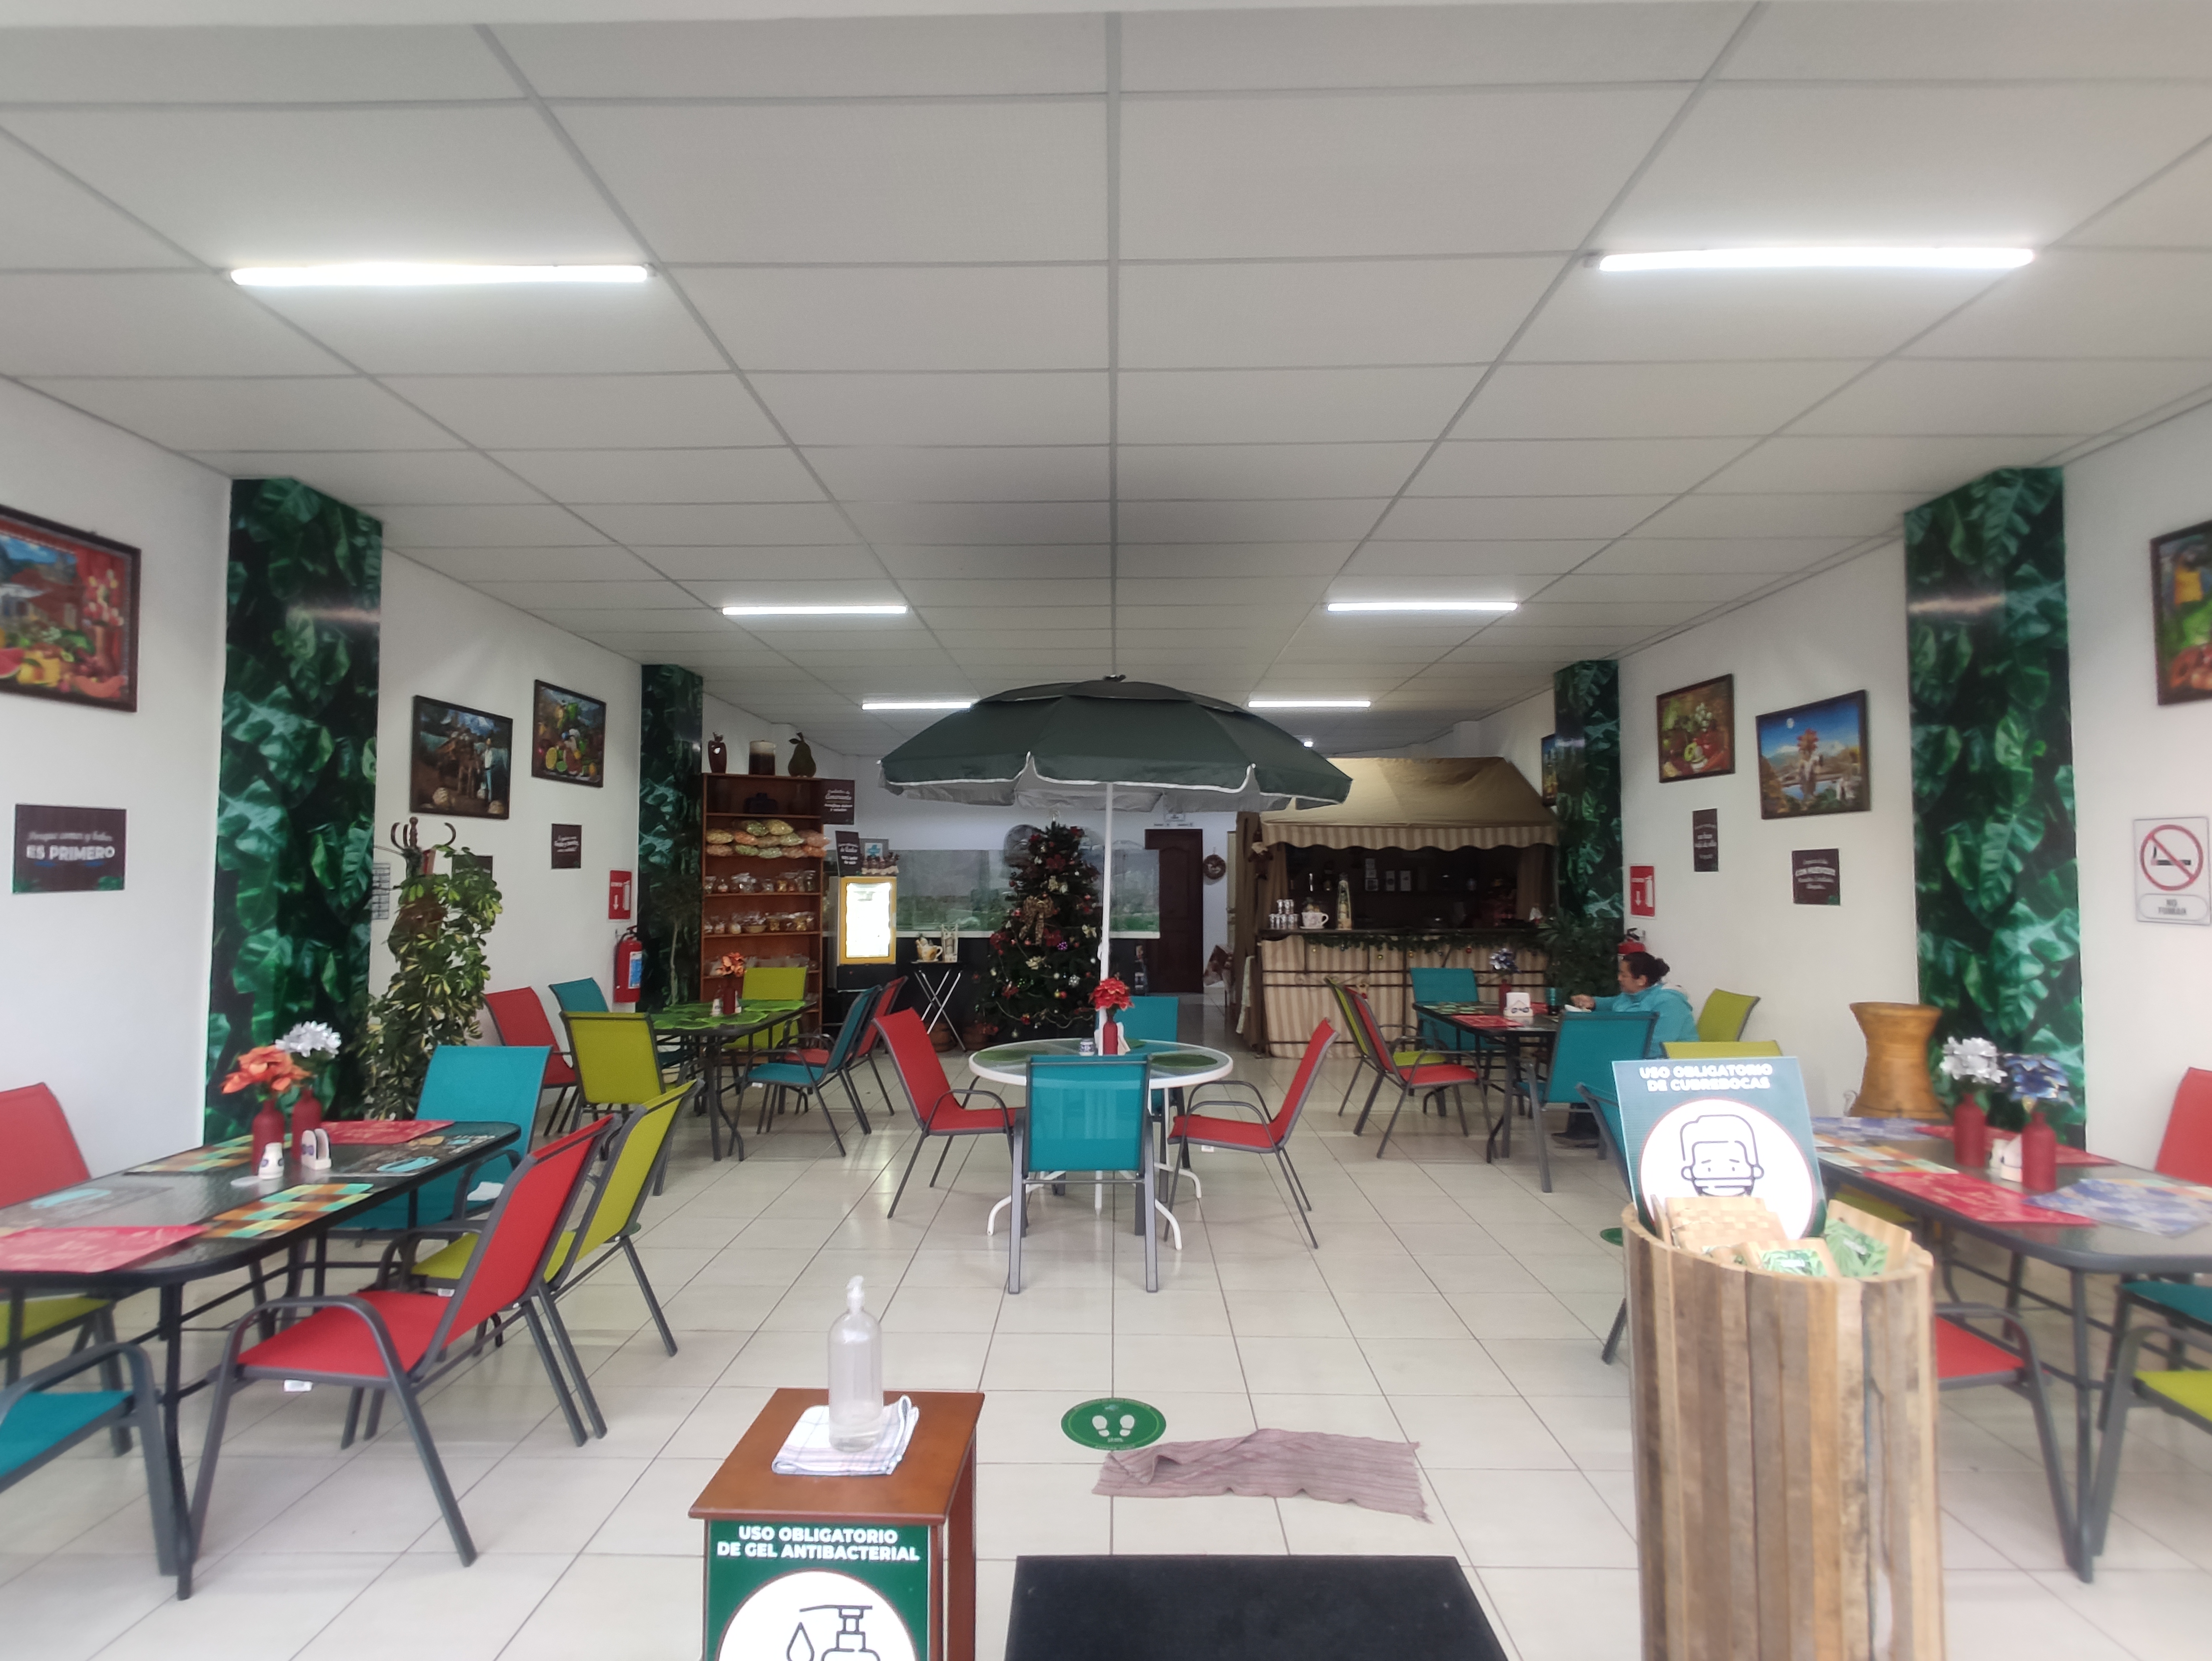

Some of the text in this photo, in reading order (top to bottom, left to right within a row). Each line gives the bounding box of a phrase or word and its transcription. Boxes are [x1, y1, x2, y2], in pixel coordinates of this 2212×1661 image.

[26, 845, 114, 860] ES PRIMERO
[1639, 1063, 1773, 1079] USO OBLIGATORIO
[1647, 1077, 1771, 1091] DE CUBREBOCAS
[738, 1526, 898, 1544] USO OBLIGATORIO
[717, 1541, 920, 1561] DE GEL ANTIBACTERIAL
